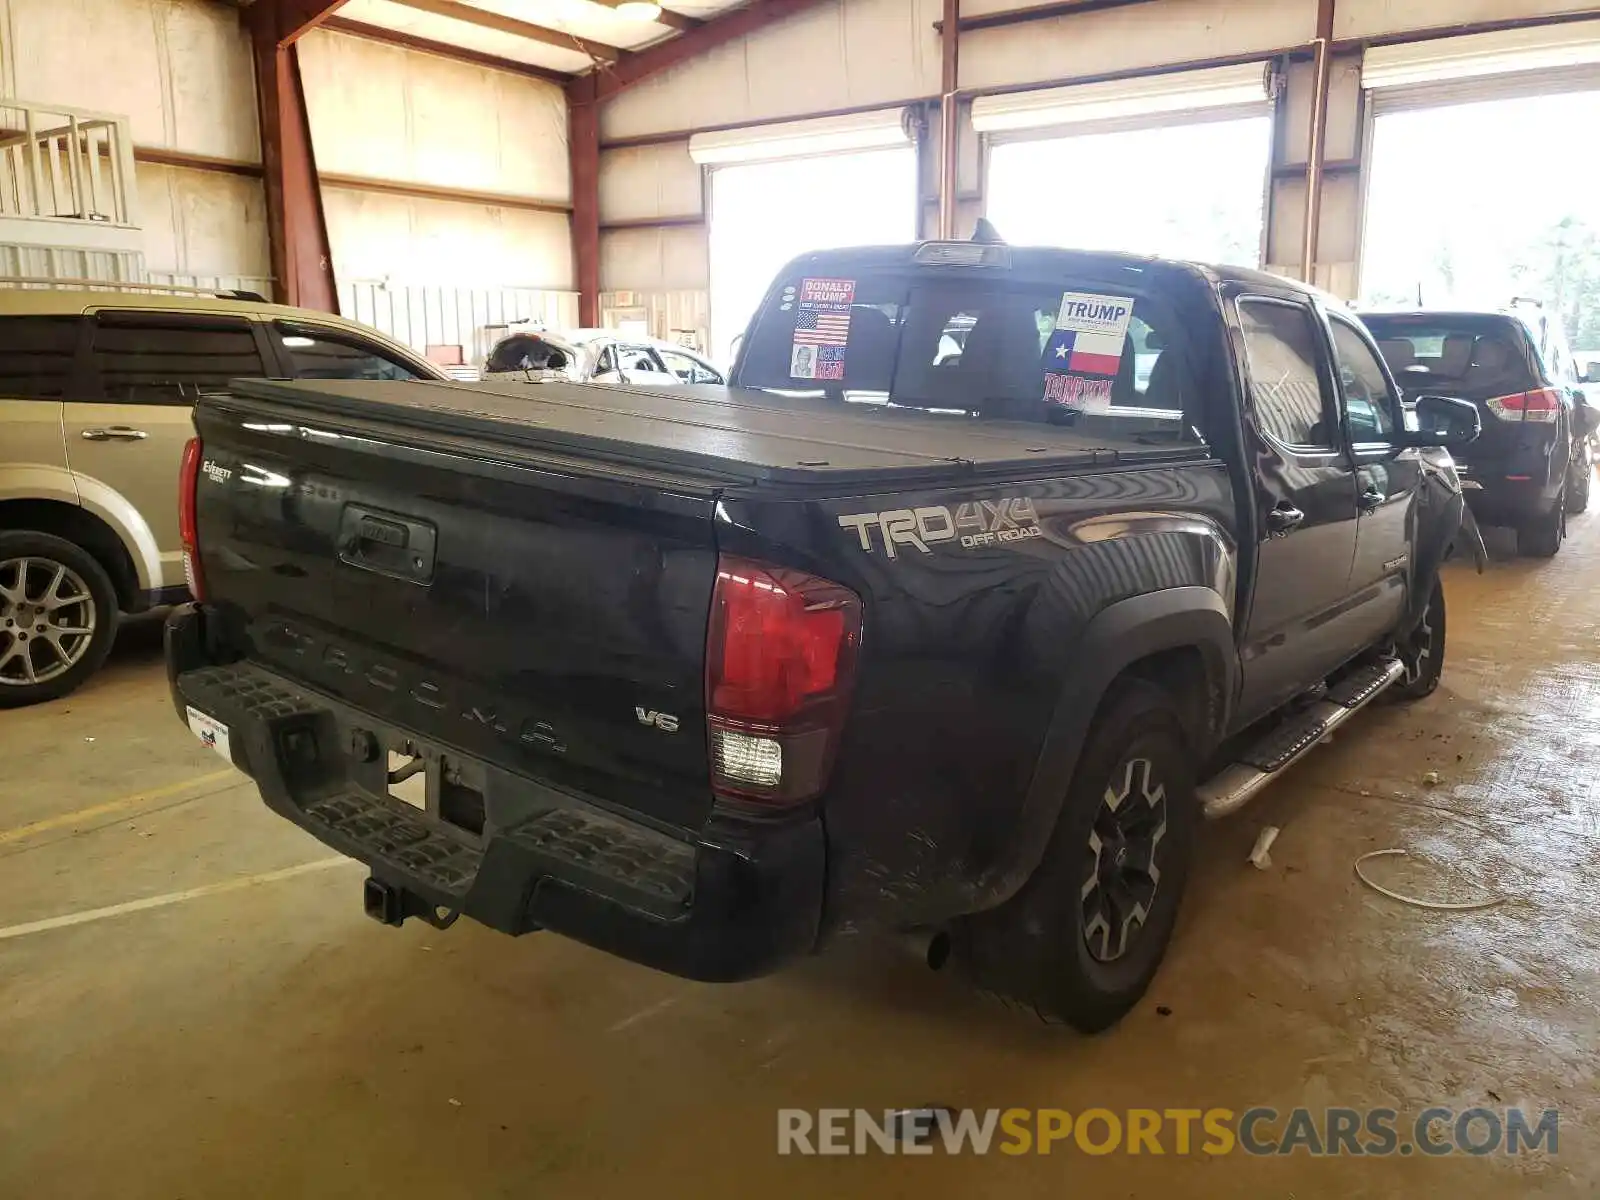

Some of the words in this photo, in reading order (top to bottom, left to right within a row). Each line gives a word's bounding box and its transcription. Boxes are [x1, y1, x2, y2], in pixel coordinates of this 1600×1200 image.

[806, 281, 852, 292] DONALD
[807, 291, 848, 301] TRUMP
[1067, 301, 1126, 322] TRUMP
[838, 505, 955, 559] TRD
[960, 531, 996, 548] OFF
[998, 526, 1044, 543] ROAD
[635, 706, 679, 732] V6
